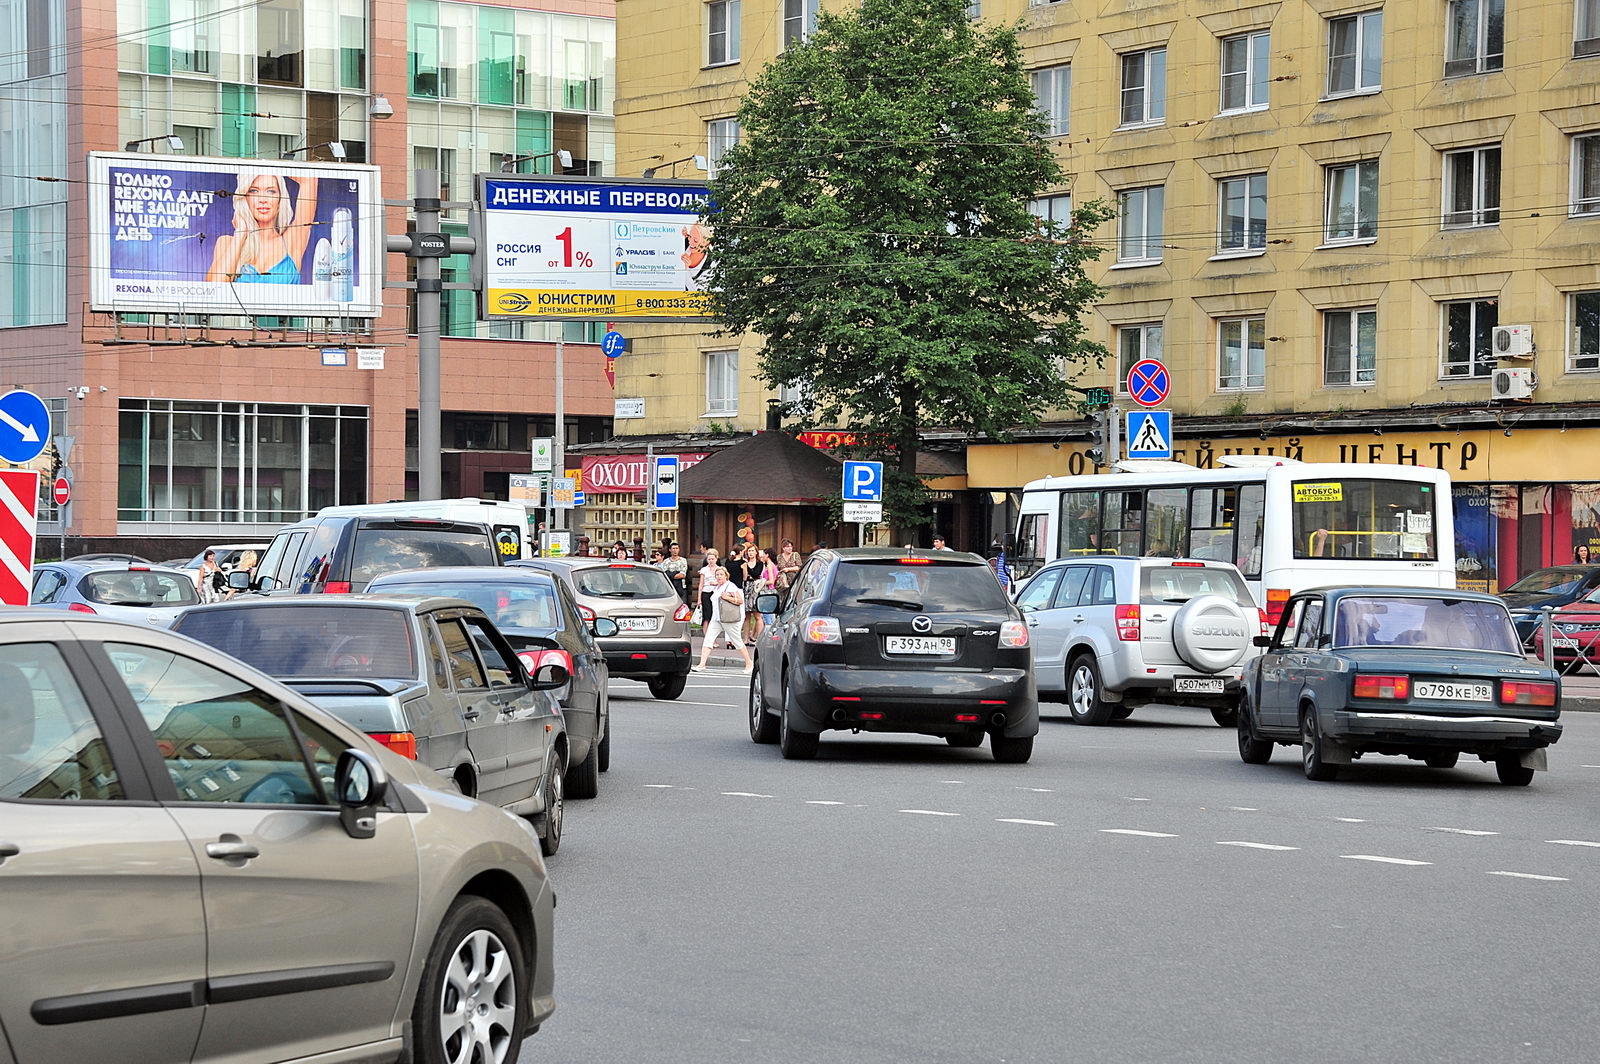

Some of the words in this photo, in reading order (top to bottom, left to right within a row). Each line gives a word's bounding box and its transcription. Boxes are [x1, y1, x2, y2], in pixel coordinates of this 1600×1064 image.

[114, 172, 172, 188] ТОЛЬКО
[114, 186, 174, 202] REXONA
[177, 190, 214, 204] ДАЕТ
[493, 187, 601, 206] ДЕНЕЖНЫЕ
[114, 200, 144, 213] МНЕ
[147, 201, 208, 217] ЗАЩИТУ
[115, 213, 137, 226] НА
[138, 214, 189, 229] ЦЕЛЫЙ
[115, 227, 153, 241] ДЕНЬ
[496, 244, 542, 253] РОССИЯ
[496, 258, 517, 267] СНГ
[177, 286, 216, 296] РОССИИ
[538, 293, 616, 306] ЮНИСТРИМ
[636, 299, 643, 308] 8
[645, 299, 665, 308] 800
[667, 299, 686, 309] 333
[578, 307, 616, 315] ПЕРЕВОДЫ
[1192, 626, 1245, 637] SUZUKI
